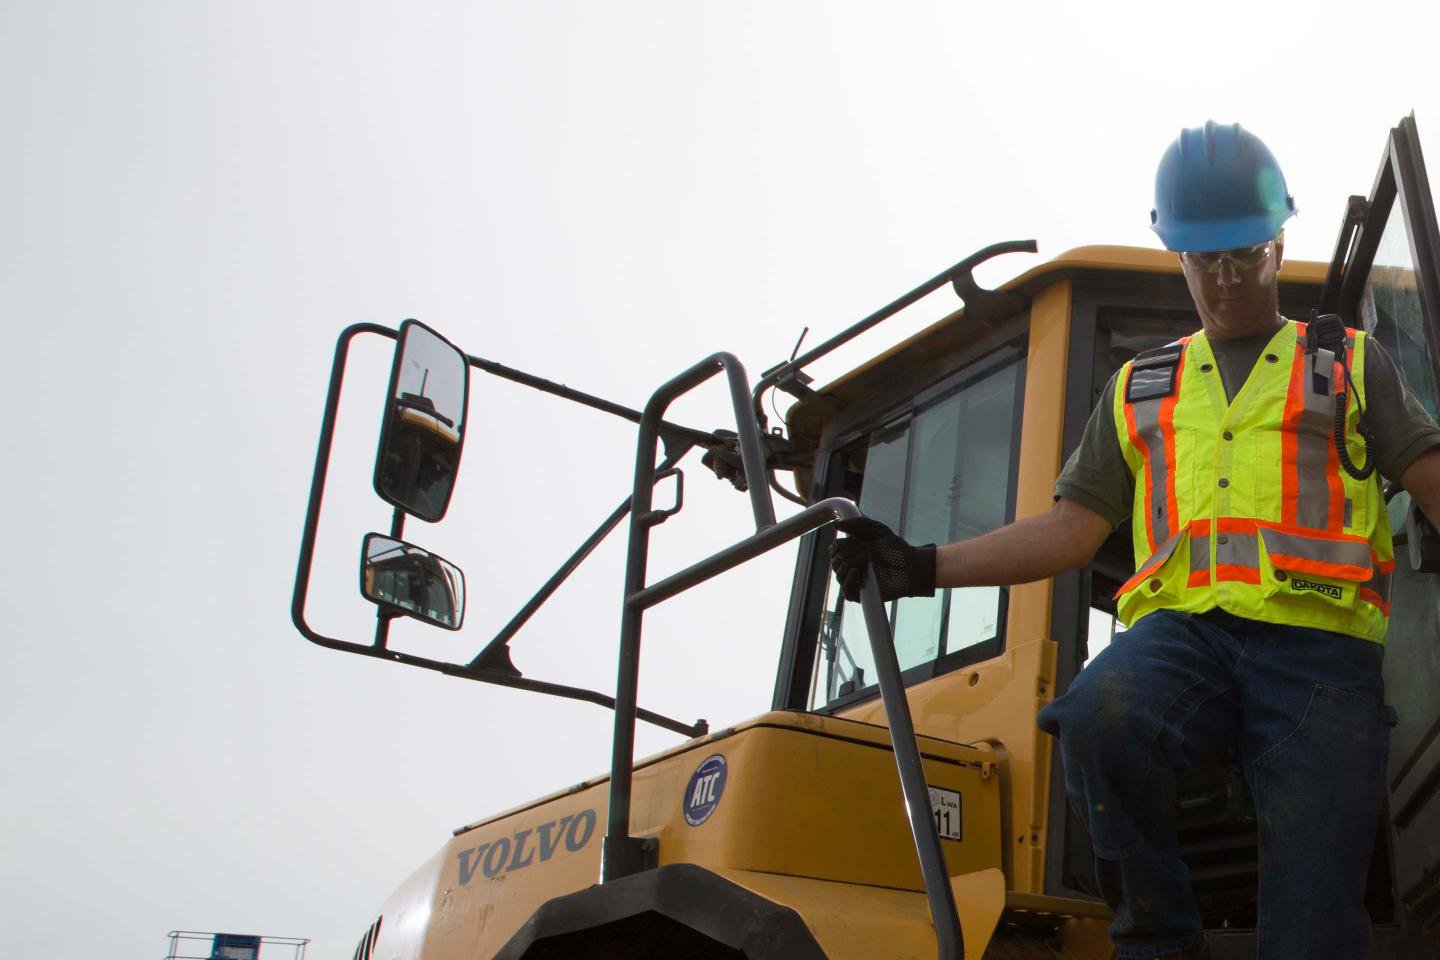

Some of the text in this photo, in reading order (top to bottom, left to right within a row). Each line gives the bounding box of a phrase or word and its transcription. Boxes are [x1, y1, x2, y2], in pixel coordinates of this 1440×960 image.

[1294, 580, 1340, 598] DAKOTA
[690, 772, 720, 808] ATC
[457, 809, 597, 886] VOLVO
